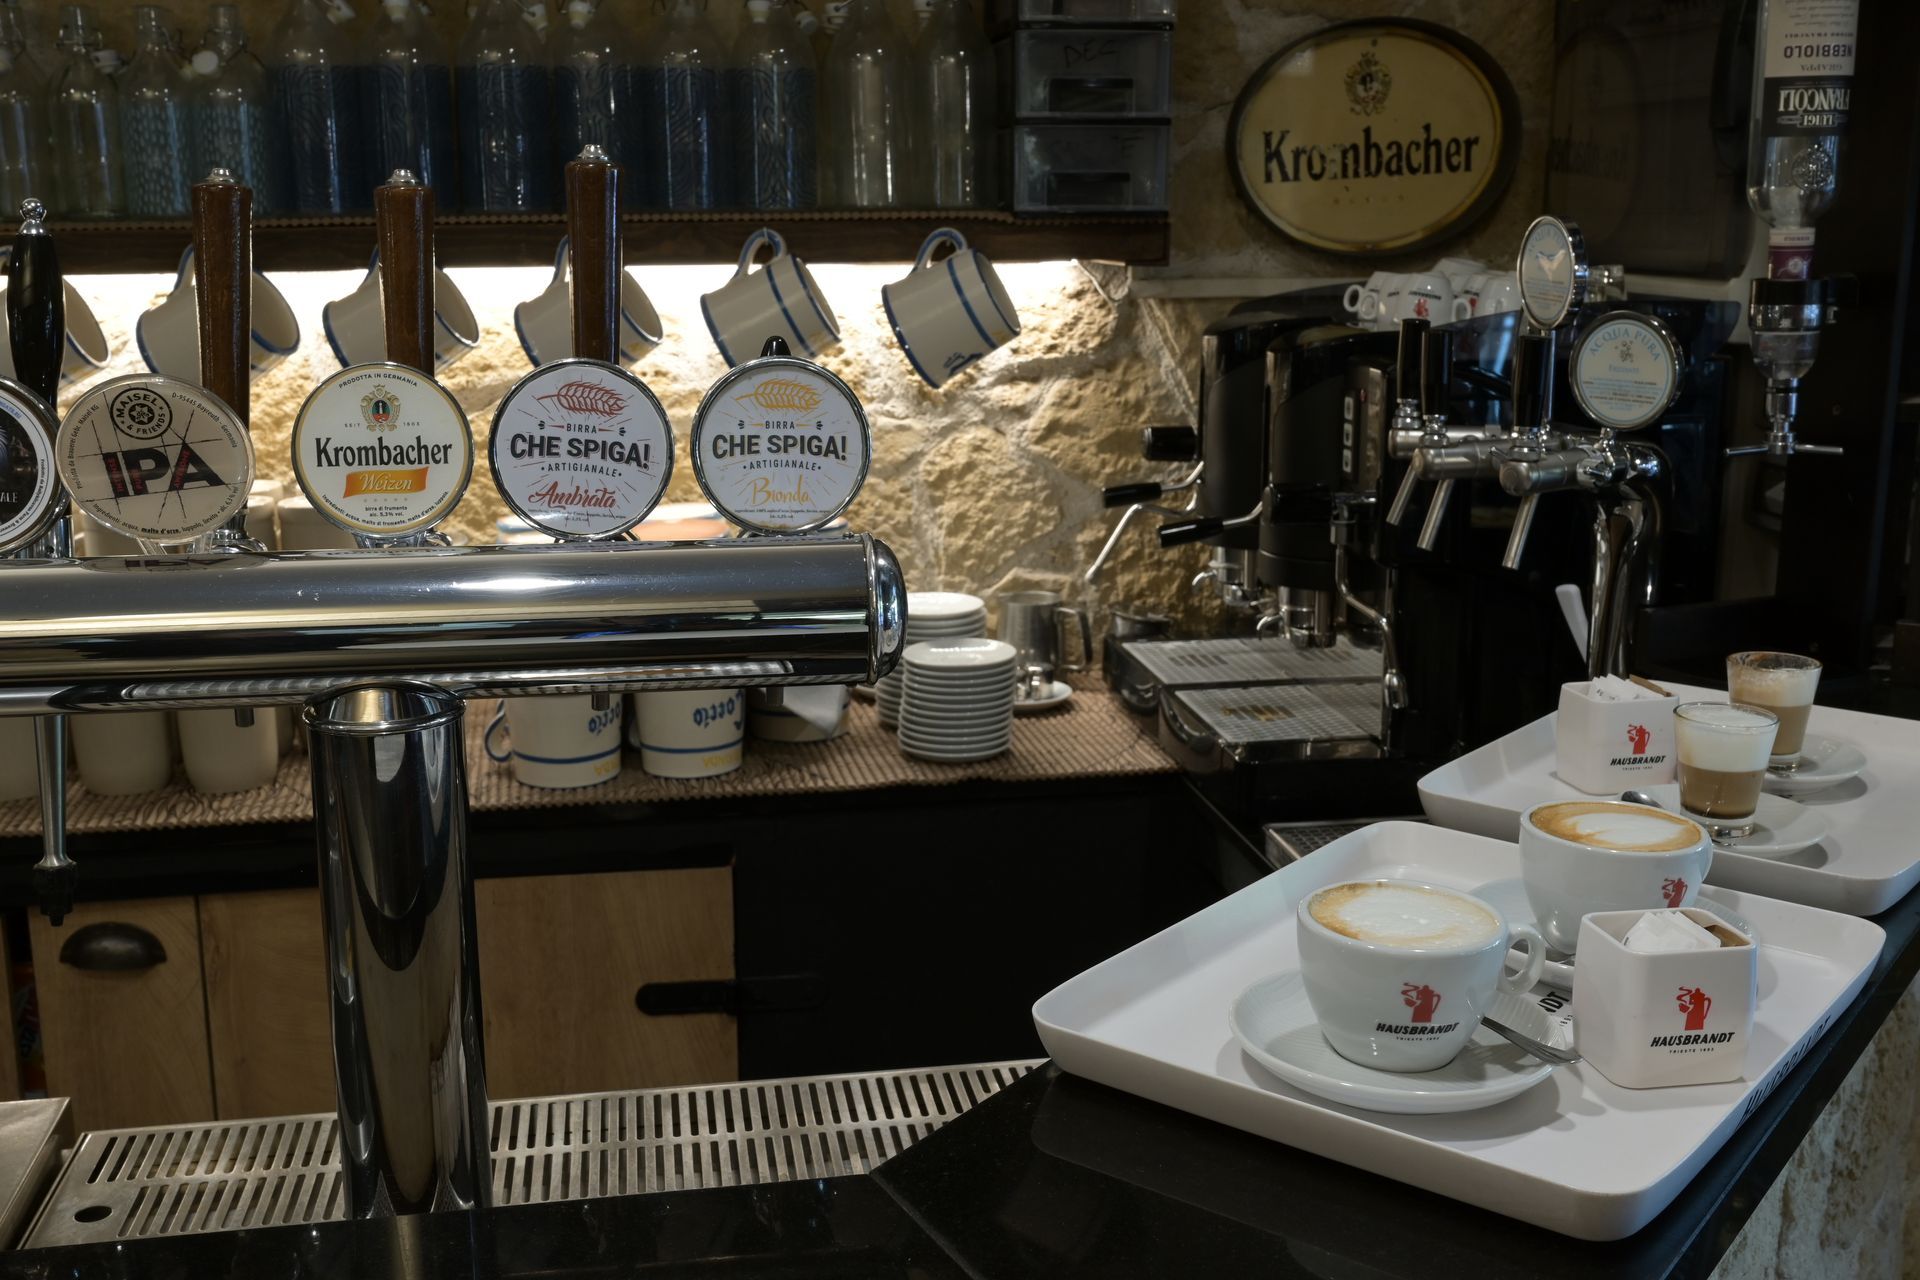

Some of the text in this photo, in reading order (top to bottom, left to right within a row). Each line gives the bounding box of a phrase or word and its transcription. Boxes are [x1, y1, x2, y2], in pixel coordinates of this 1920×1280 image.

[1783, 44, 1853, 58] NEBBIOLO
[1778, 88, 1850, 112] FRANCOLI
[1803, 114, 1834, 126] LUIGI
[338, 373, 373, 389] PRODOTTA
[383, 373, 418, 388] GERMANIA
[116, 393, 157, 418] MAISEL
[136, 412, 166, 434] FRIENDS
[566, 423, 597, 434] BIRRA
[765, 420, 796, 430] BIRRA
[315, 435, 453, 467] Krombacher
[511, 433, 650, 470] CHE SPIGA!
[712, 434, 847, 461] CHE SPIGA!
[102, 442, 226, 498] IPA
[547, 462, 618, 477] ARTIGIANALE
[749, 459, 817, 472] ARTIGIANALE
[359, 471, 413, 491] Weizen
[528, 480, 617, 510] Ambrata
[748, 474, 811, 507] Bionda
[1610, 755, 1667, 766] HAUSBRANDT
[1376, 1022, 1460, 1035] HAUSBRANDT
[1650, 1031, 1736, 1047] HAUSBRANDT
